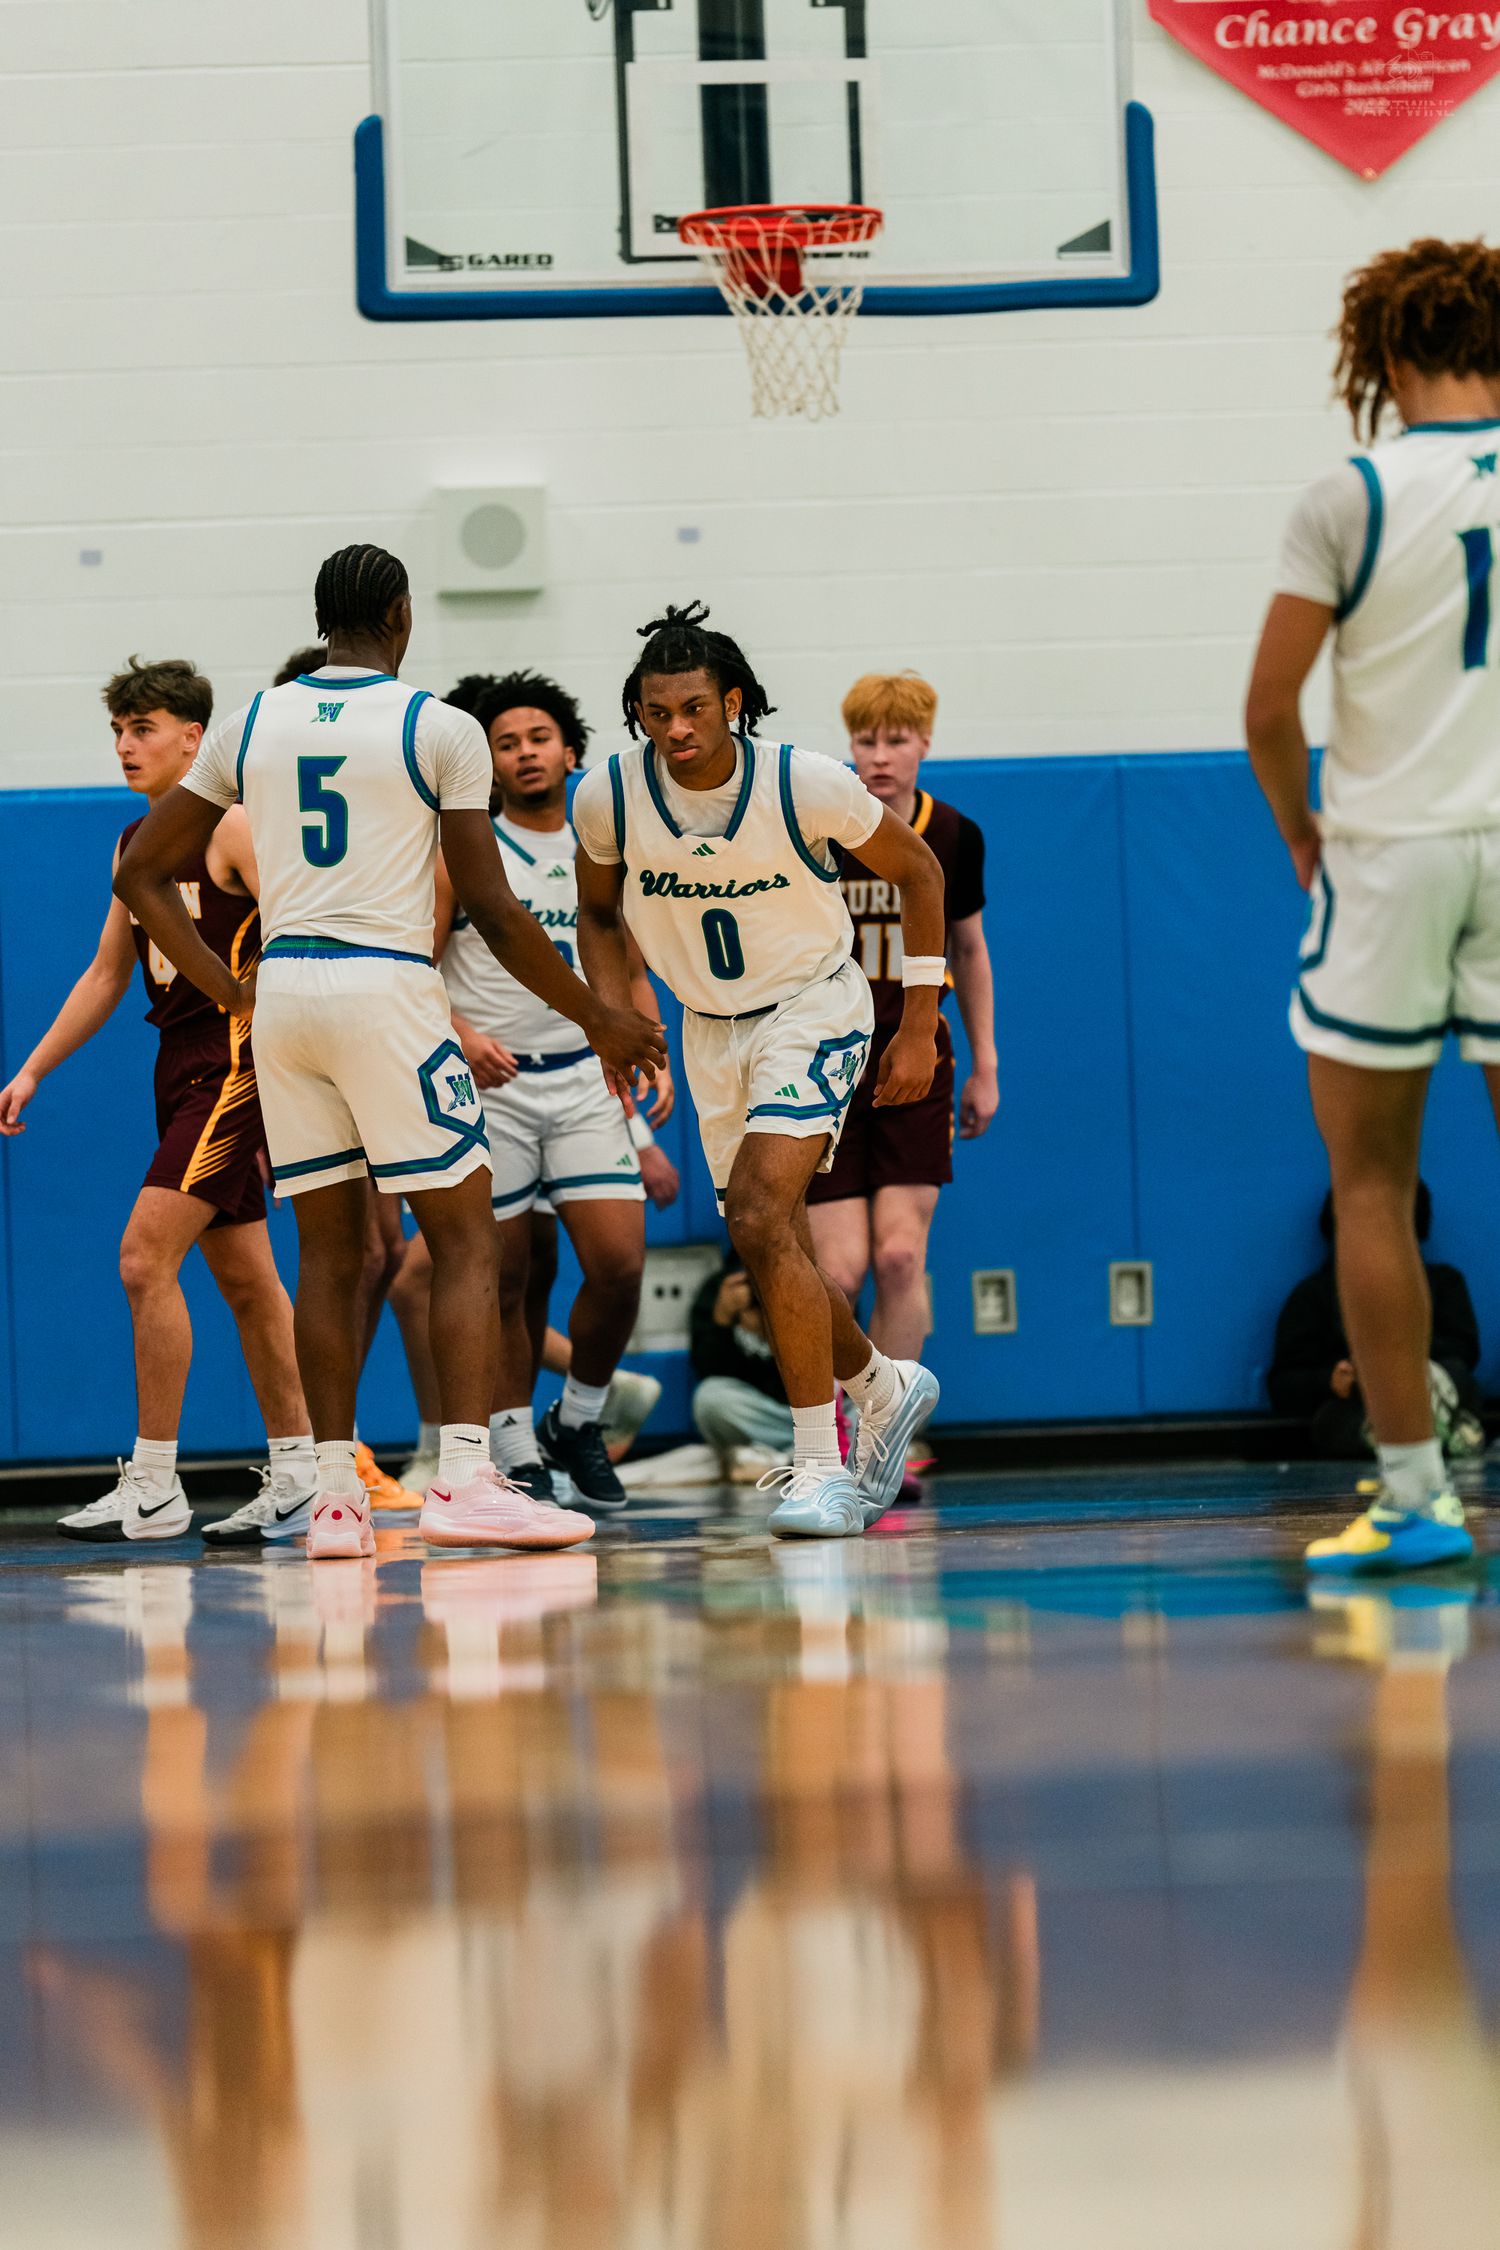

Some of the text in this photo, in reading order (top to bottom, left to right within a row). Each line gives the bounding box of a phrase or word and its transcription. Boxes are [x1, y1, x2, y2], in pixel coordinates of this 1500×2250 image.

[1215, 7, 1500, 50] Chance Gray
[468, 253, 555, 266] GARED
[297, 756, 349, 868] 5
[639, 869, 791, 899] Warriors
[701, 908, 746, 981] 0
[859, 922, 903, 981] 11
